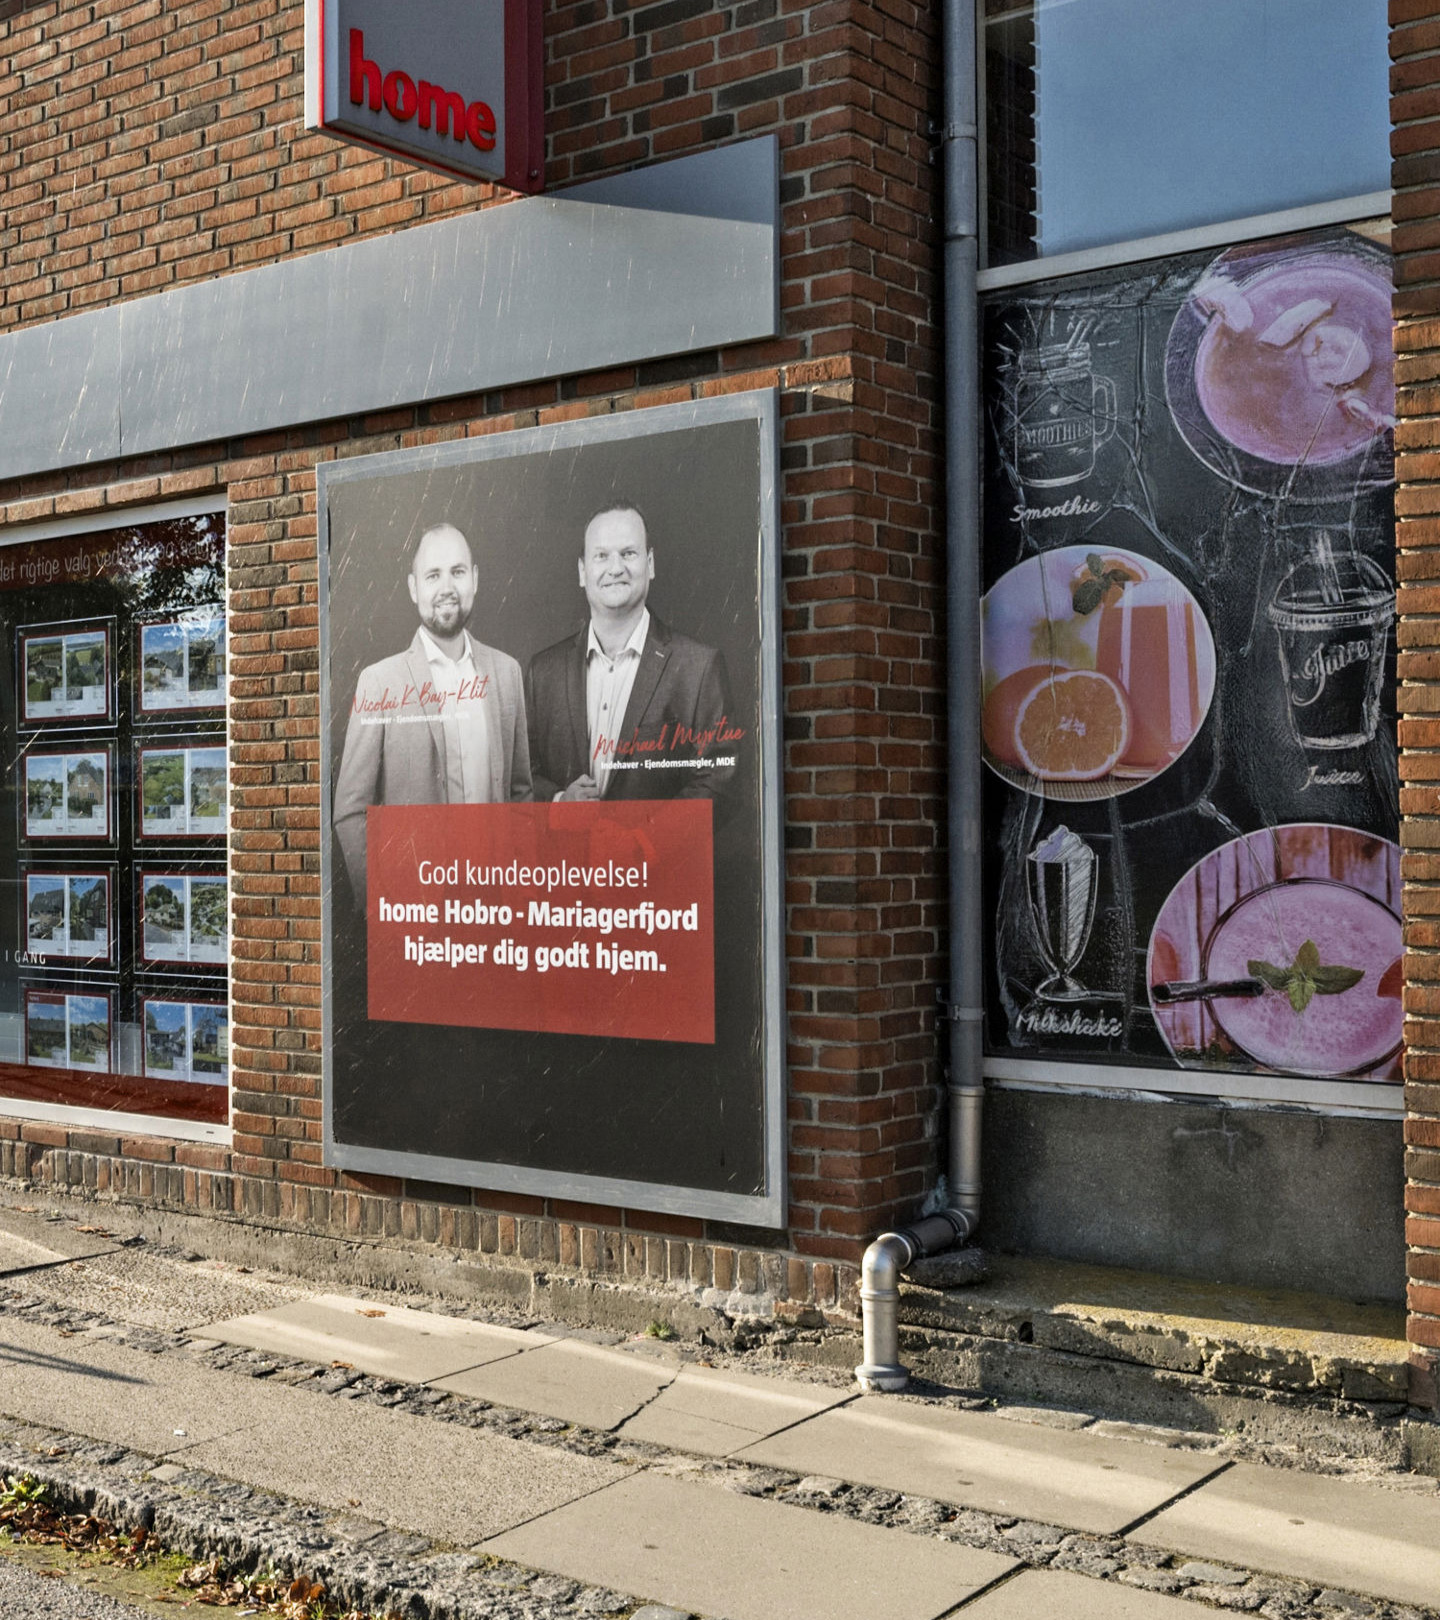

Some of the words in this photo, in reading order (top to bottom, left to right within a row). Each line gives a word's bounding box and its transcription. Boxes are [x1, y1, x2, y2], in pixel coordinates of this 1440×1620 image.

[349, 27, 497, 152] home
[1009, 495, 1101, 522] Smoothie
[20, 556, 60, 585] rigtige
[64, 547, 91, 577] valg
[350, 687, 399, 717] Nicolai
[419, 674, 489, 714] Bay-Klit
[593, 724, 667, 761] Michael
[671, 715, 746, 756] Myrtue
[600, 759, 639, 770] Indehaver
[644, 757, 715, 770] Ejendomsmægler,
[716, 756, 736, 767] MDE
[418, 859, 459, 886] God
[465, 859, 648, 893] kundeoplevelse!
[379, 896, 439, 924] home
[444, 898, 513, 926] Hobro
[527, 900, 698, 935] Mariagerfjord
[14, 950, 46, 965] GANG
[404, 935, 487, 968] hjælper
[492, 938, 529, 972] dig
[534, 941, 590, 973] godt
[595, 942, 667, 976] hjem.
